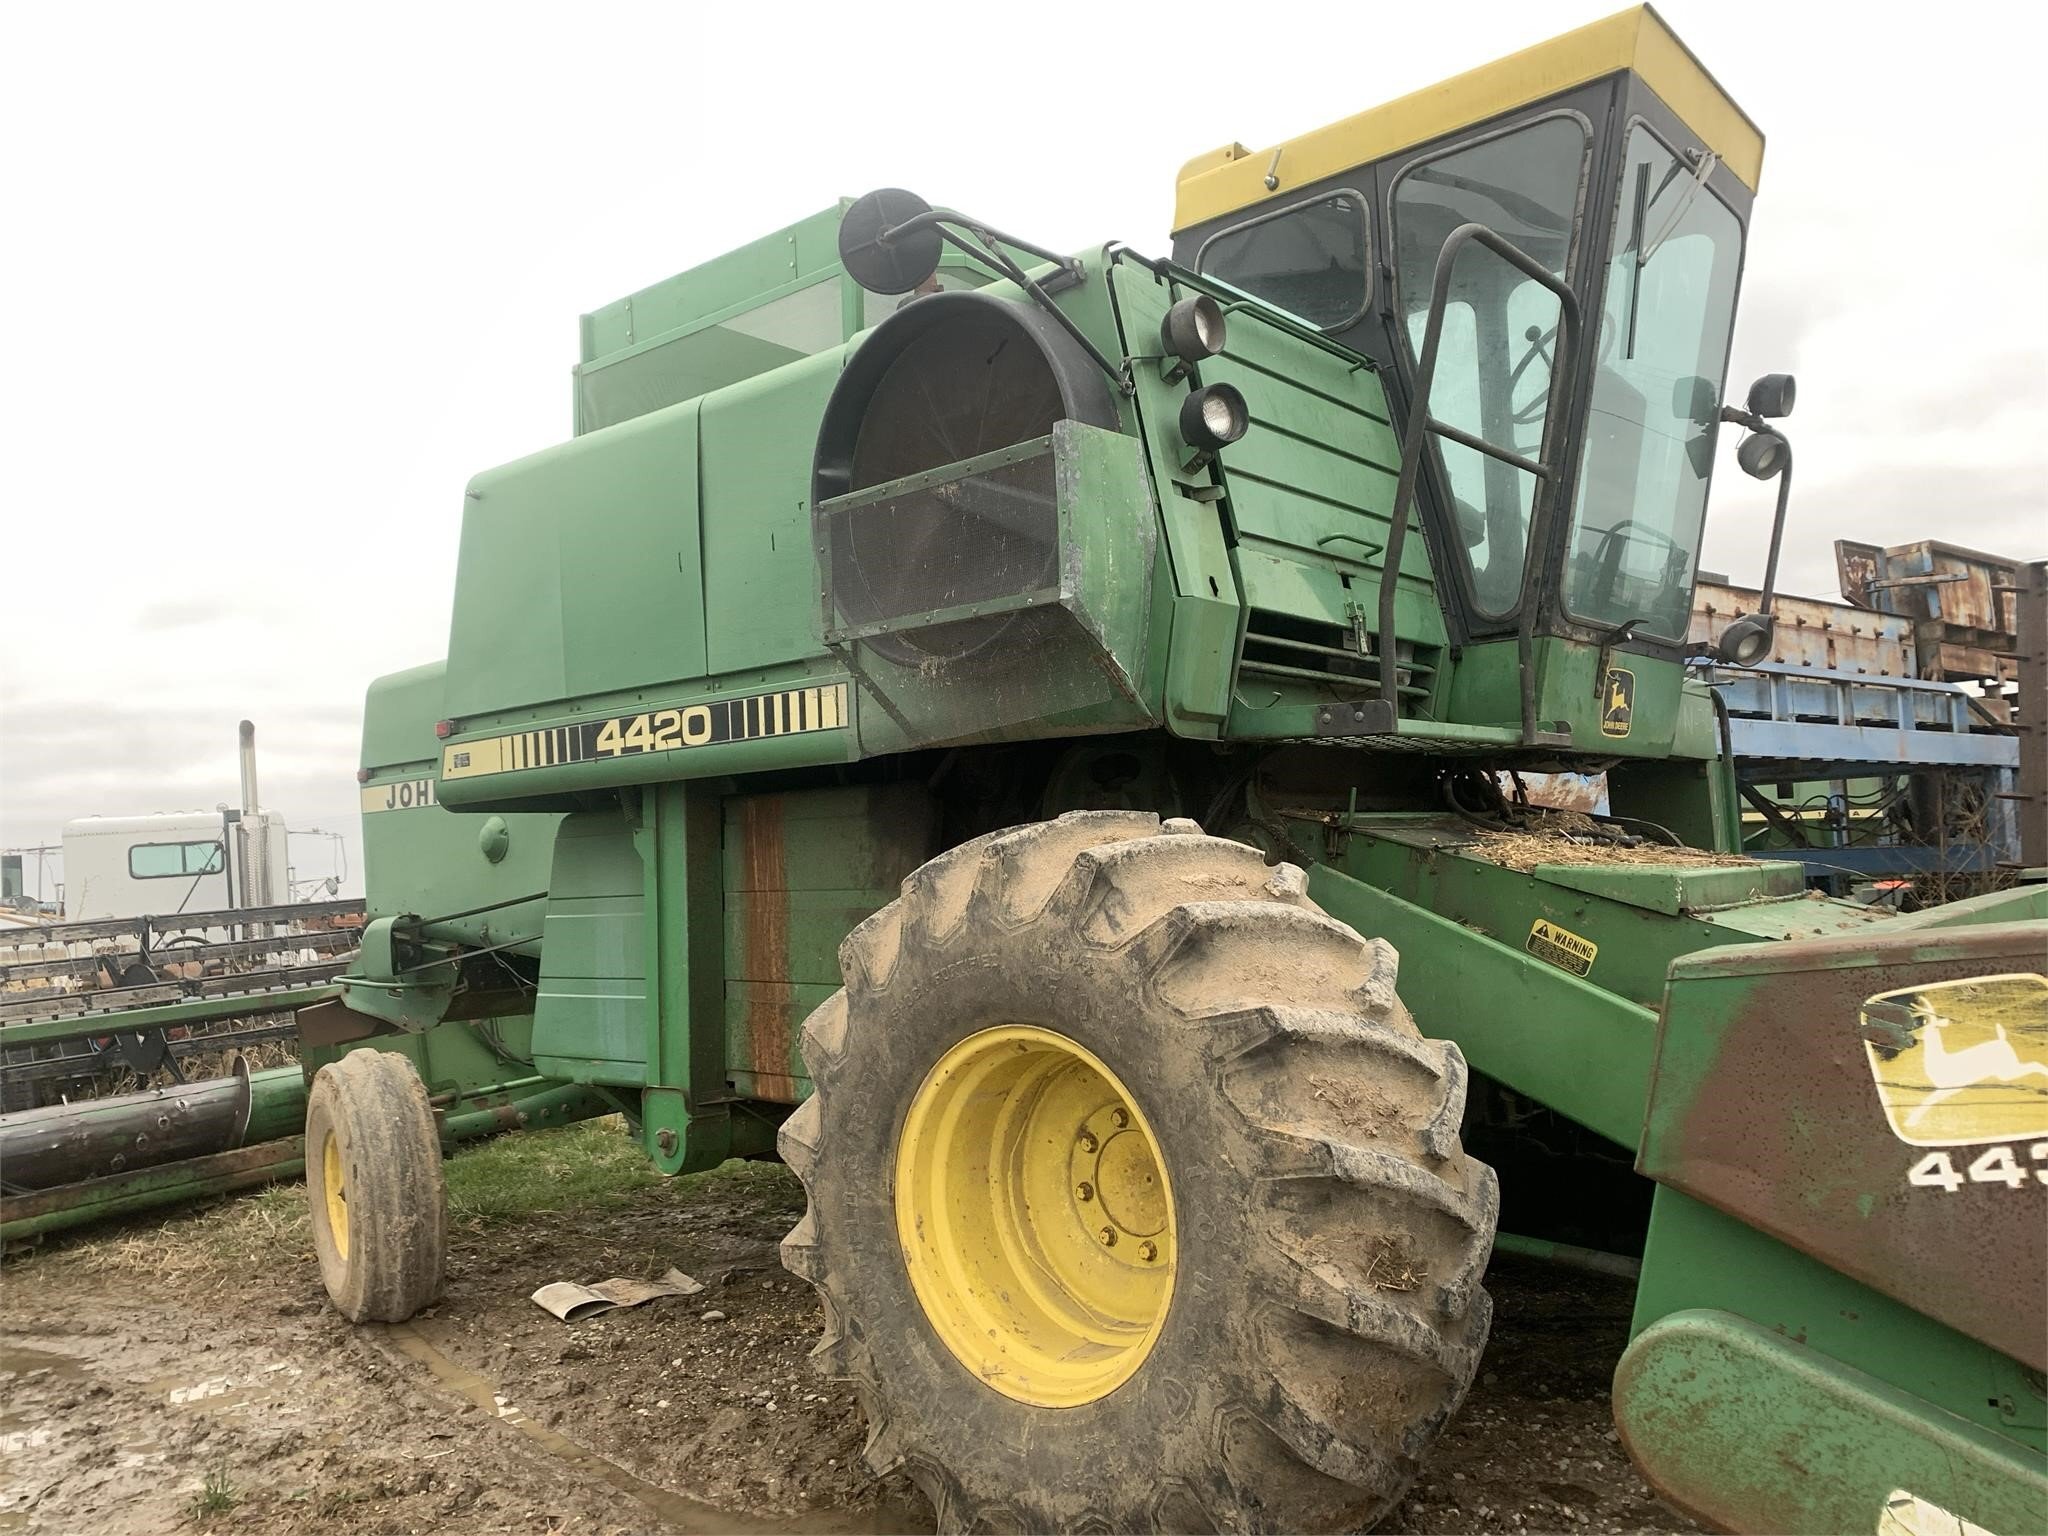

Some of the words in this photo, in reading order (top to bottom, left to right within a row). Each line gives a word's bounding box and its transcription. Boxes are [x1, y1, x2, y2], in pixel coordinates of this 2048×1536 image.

[596, 705, 712, 756] 4420
[1603, 720, 1615, 730] JOHN
[1615, 721, 1630, 731] DEERE
[386, 780, 438, 810] JOH
[1553, 931, 1595, 959] WARNING
